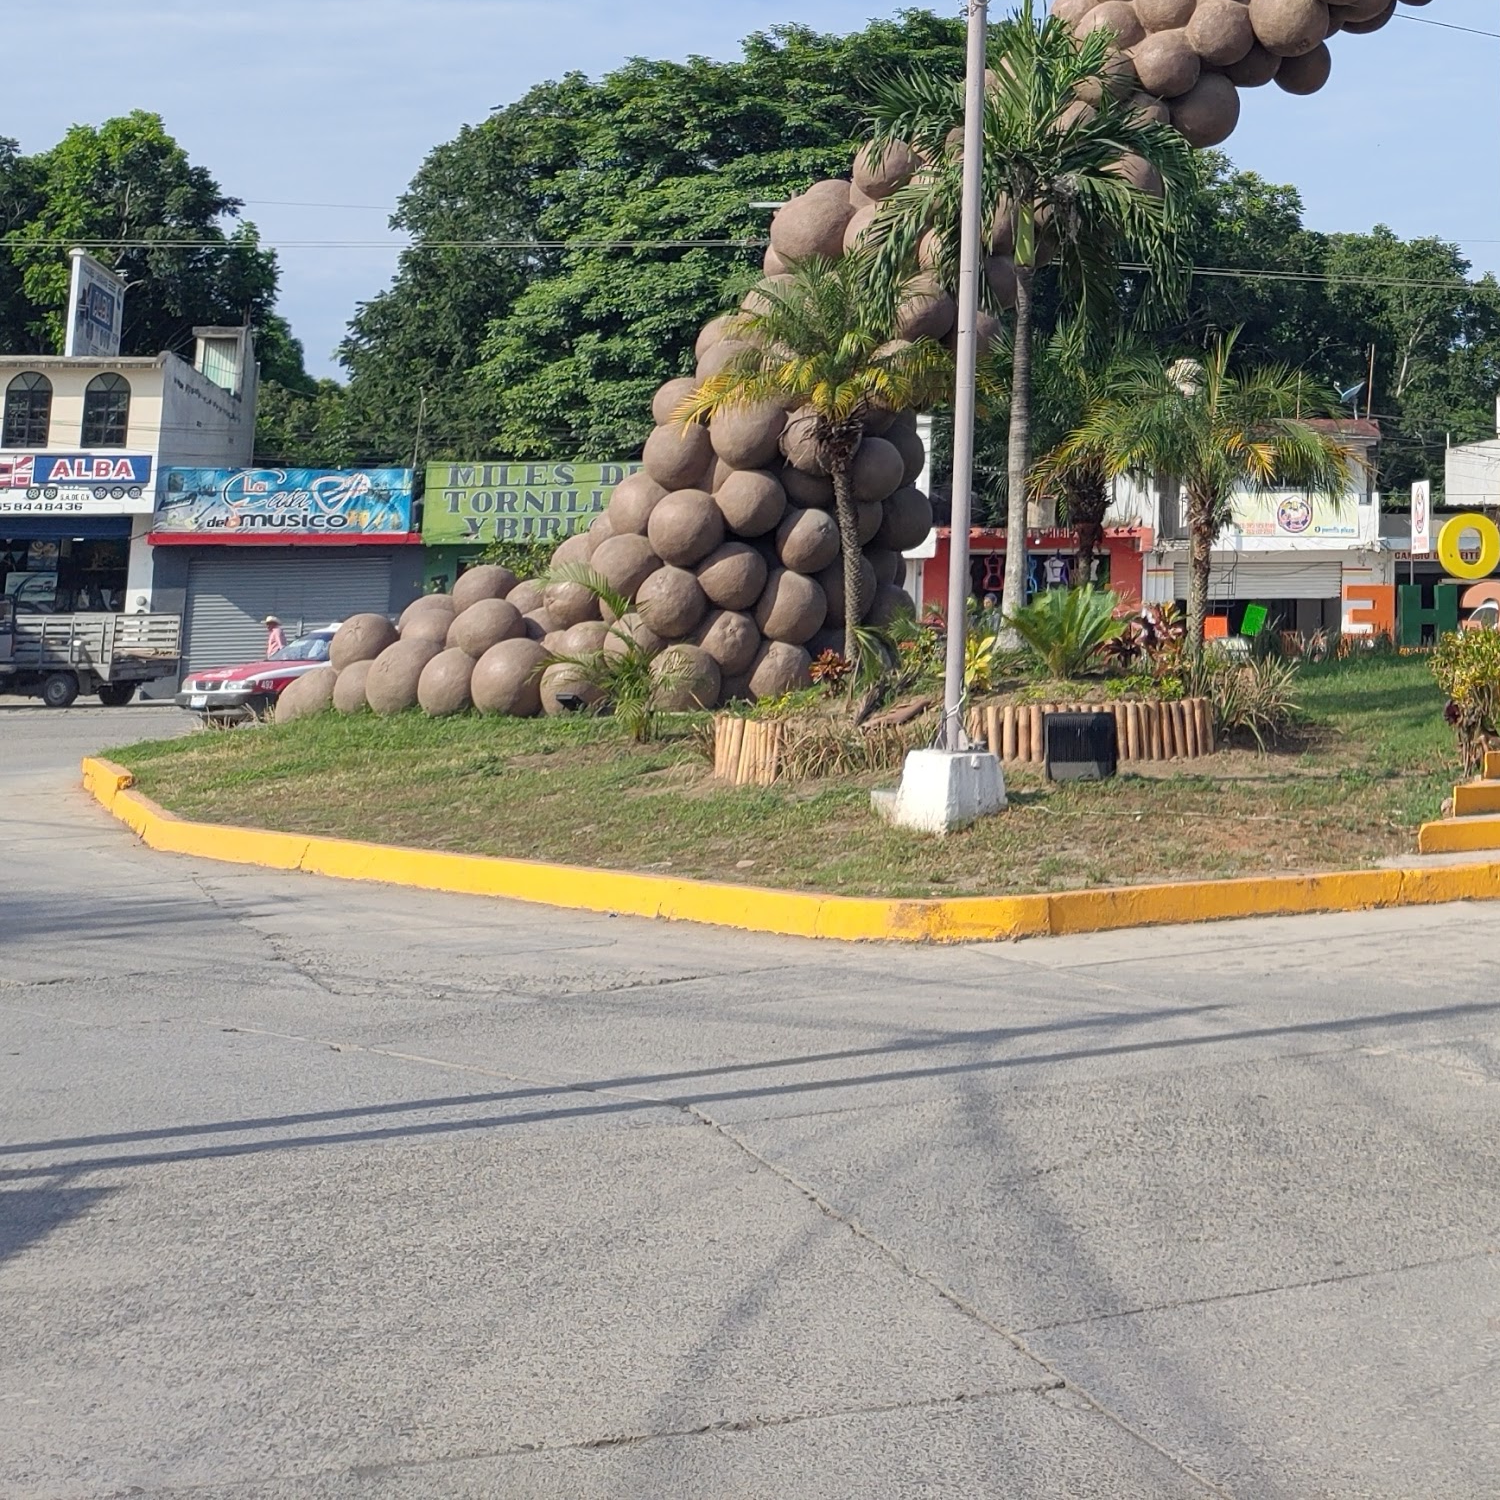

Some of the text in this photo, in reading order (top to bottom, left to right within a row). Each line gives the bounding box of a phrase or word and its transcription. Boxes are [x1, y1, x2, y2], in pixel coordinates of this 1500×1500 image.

[48, 458, 136, 481] ALBA
[449, 464, 643, 488] MILES D
[222, 470, 312, 514] Casa
[243, 476, 269, 495] La
[239, 508, 349, 528] musico
[464, 517, 489, 539] Y
